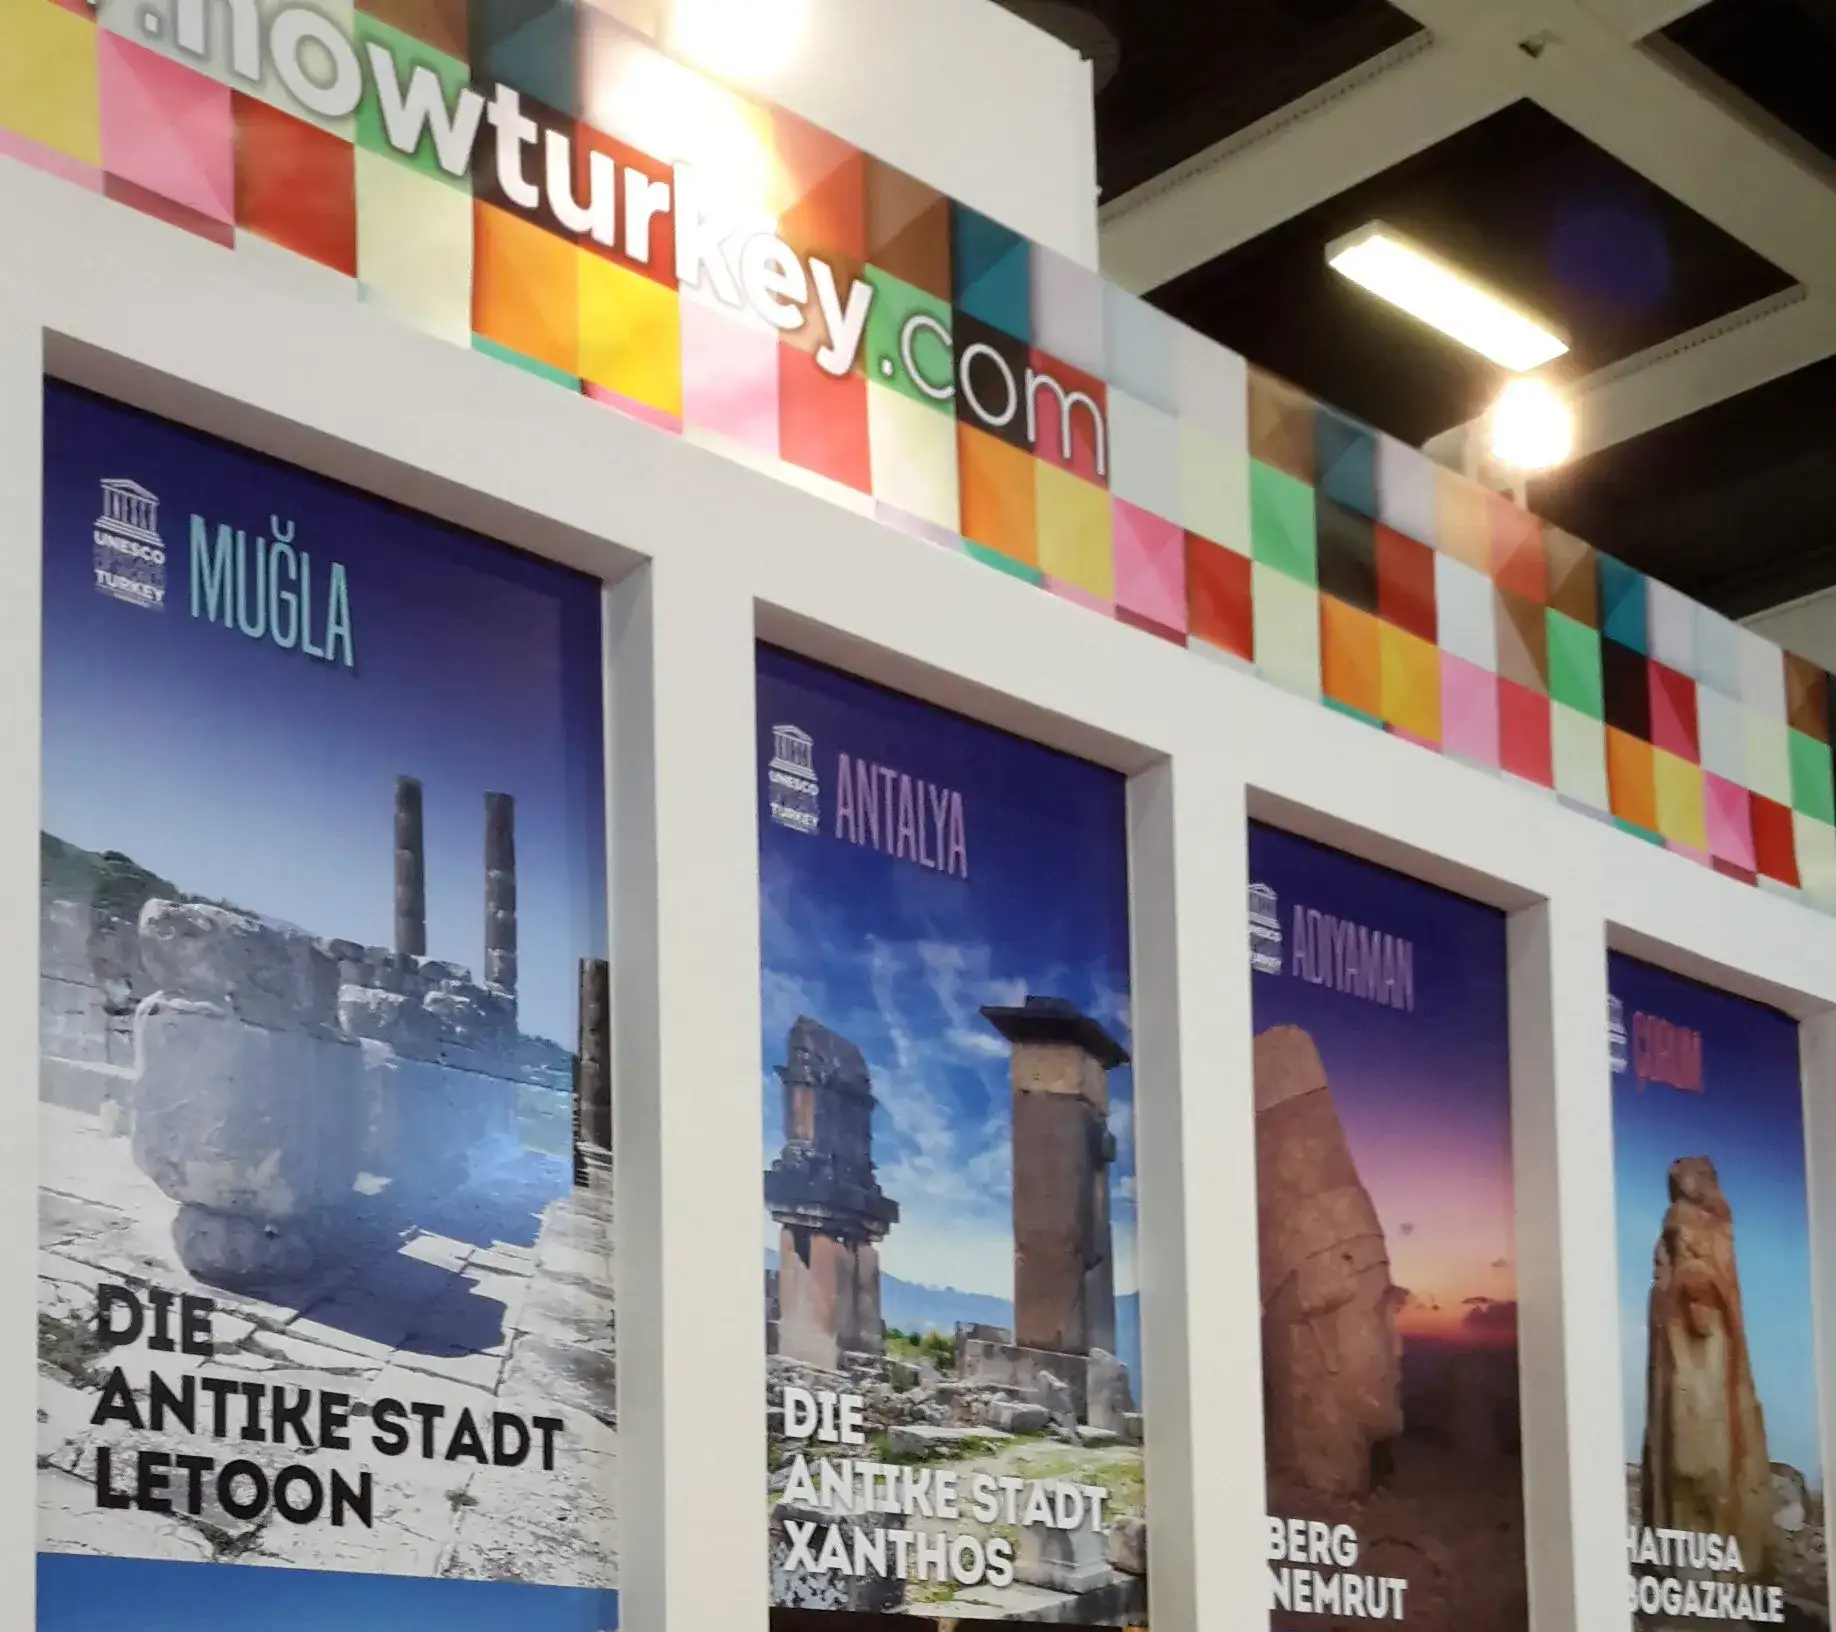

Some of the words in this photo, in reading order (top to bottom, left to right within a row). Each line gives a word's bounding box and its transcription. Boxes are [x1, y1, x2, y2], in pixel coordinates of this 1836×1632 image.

[190, 513, 353, 667] MUĞLA
[835, 753, 967, 878] ANTALYA
[97, 1283, 216, 1357] DIE
[91, 1365, 351, 1451] ANTIKE
[371, 1397, 564, 1471] STADT
[783, 1386, 865, 1445] DIE
[96, 1446, 374, 1529] LETOON
[781, 1454, 959, 1520] ANTIKE
[972, 1473, 1107, 1532] STADT
[783, 1519, 1014, 1587] XANTHOS
[1267, 1515, 1359, 1568] BERG
[1266, 1562, 1408, 1620] NEMRUT
